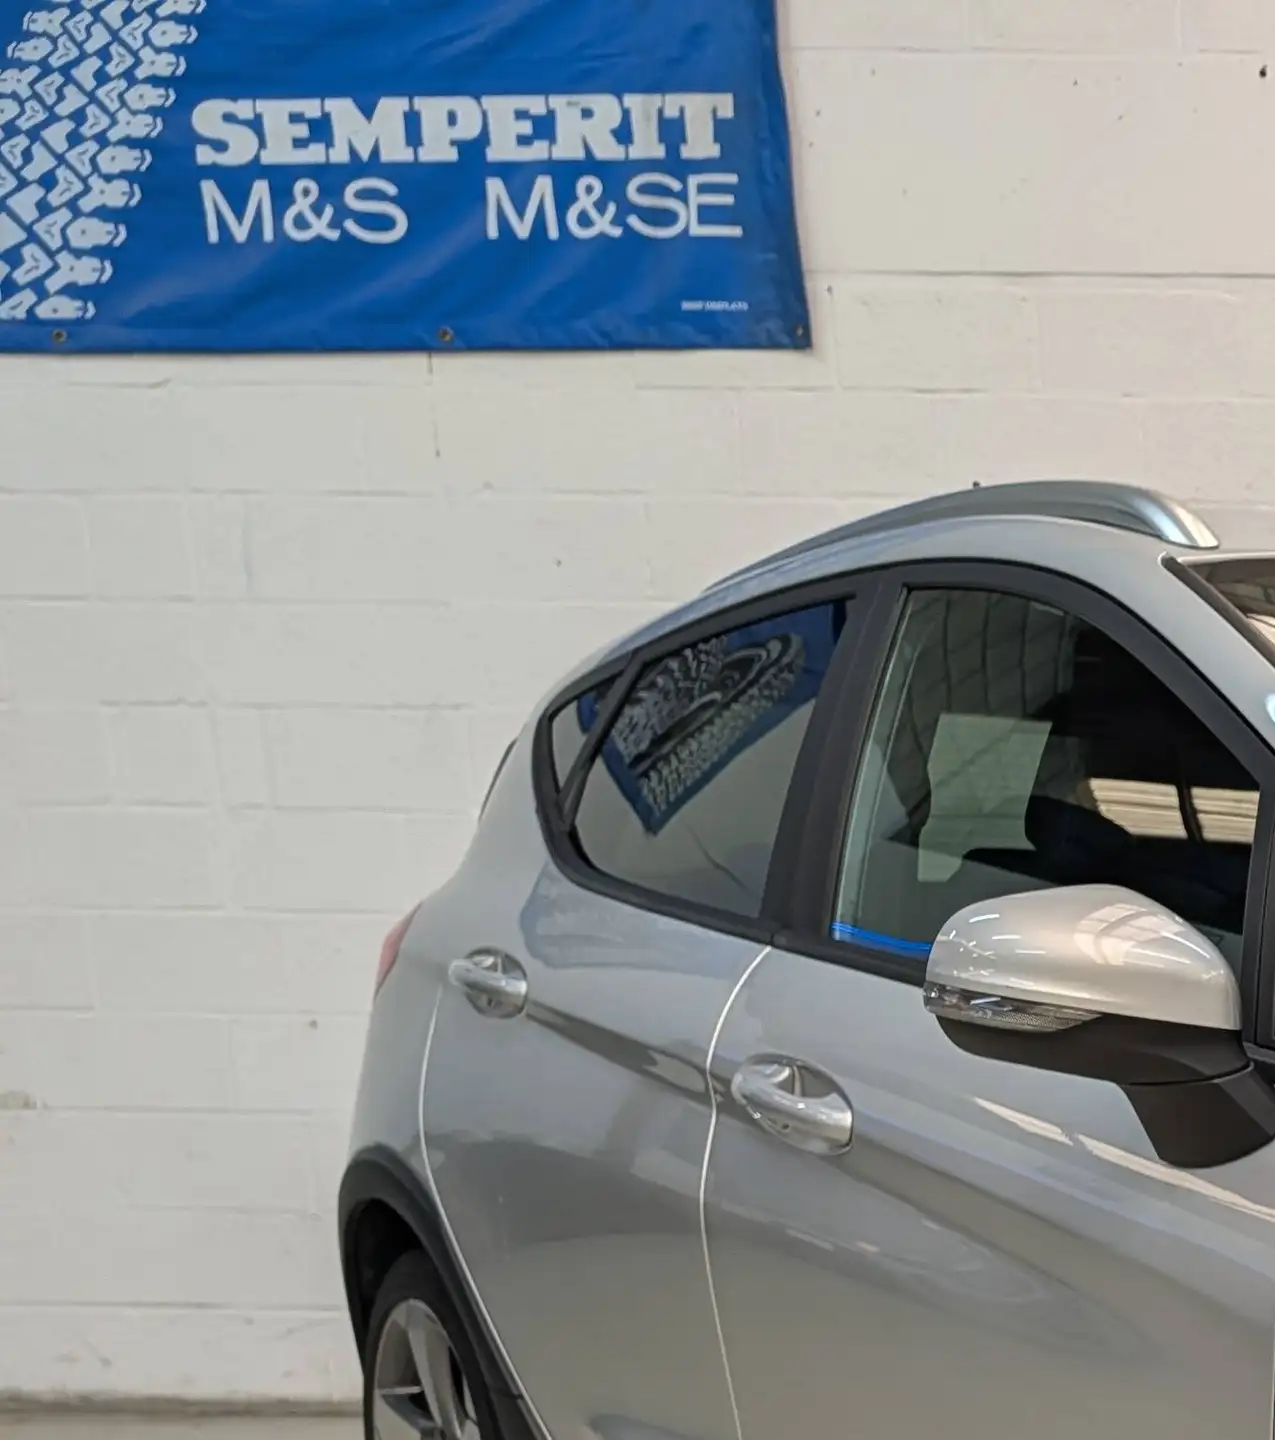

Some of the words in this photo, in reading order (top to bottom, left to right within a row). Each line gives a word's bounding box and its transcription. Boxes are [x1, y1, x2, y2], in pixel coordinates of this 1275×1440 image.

[191, 93, 734, 166] SEMPERIT
[201, 177, 408, 244] M&S
[485, 172, 743, 241] M&SE
